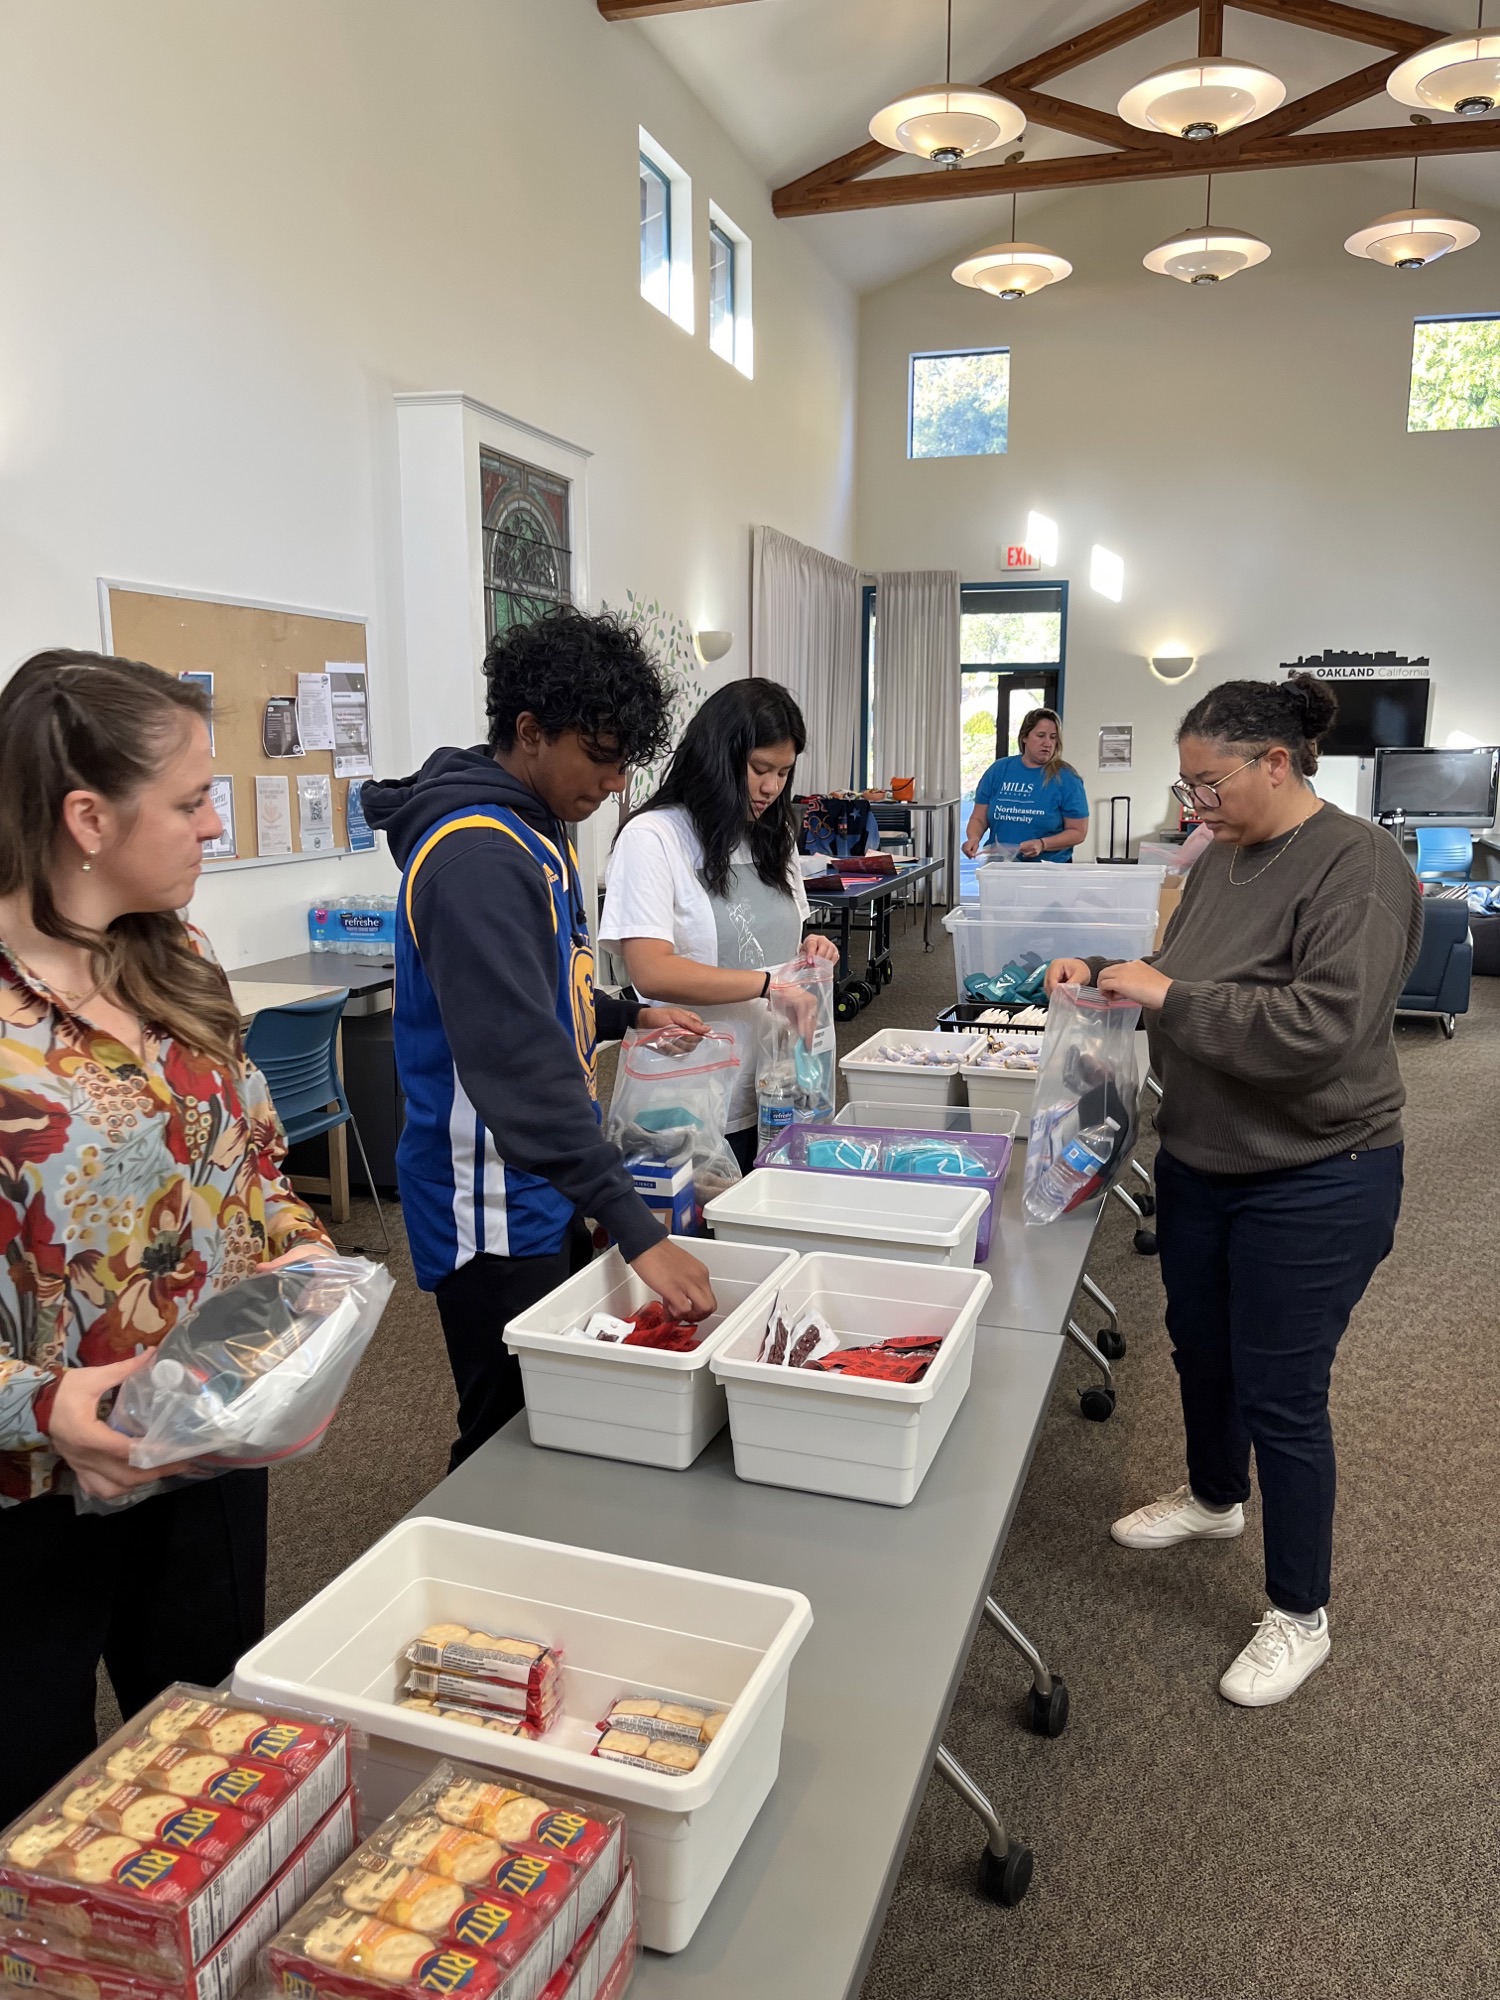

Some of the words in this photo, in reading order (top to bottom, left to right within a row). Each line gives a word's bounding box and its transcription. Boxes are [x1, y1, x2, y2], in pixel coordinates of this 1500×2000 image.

[1316, 668, 1374, 678] OAKLAND
[1378, 667, 1429, 677] California
[1001, 782, 1034, 793] MILLS
[994, 813, 1033, 824] University
[995, 805, 1045, 815] Northeastern
[344, 917, 380, 927] refreshe
[251, 1724, 304, 1760] RITZ
[209, 1767, 266, 1804] RITZ
[162, 1807, 221, 1848] RITZ
[539, 1811, 588, 1850] RITZ
[118, 1848, 181, 1890] RITZ
[498, 1854, 551, 1898] RITZ
[456, 1901, 513, 1948] RITZ
[420, 1950, 479, 1995] RITZ
